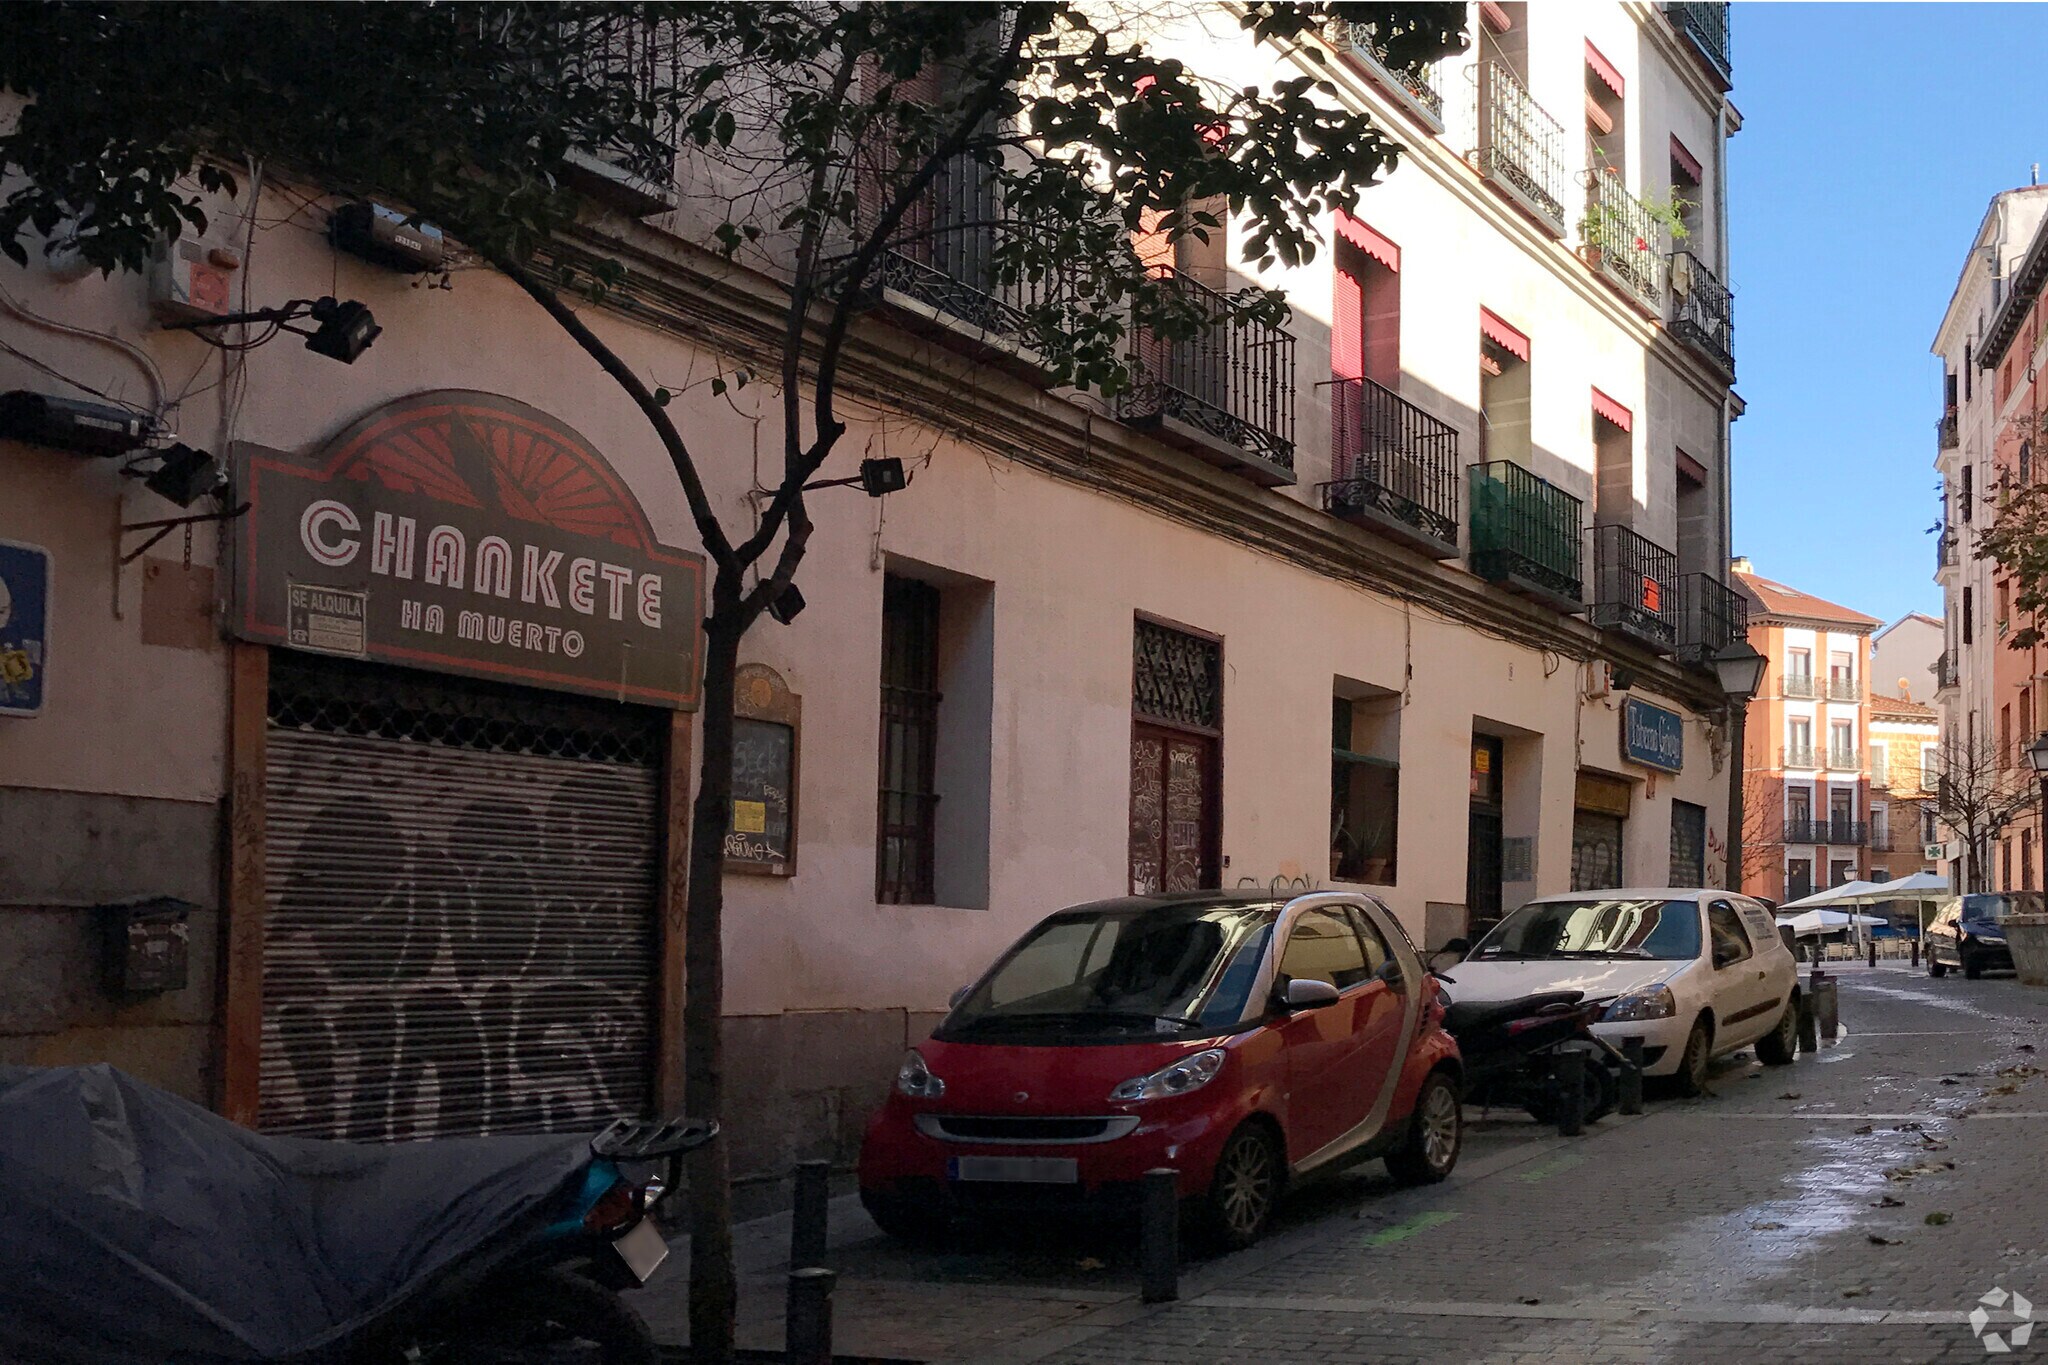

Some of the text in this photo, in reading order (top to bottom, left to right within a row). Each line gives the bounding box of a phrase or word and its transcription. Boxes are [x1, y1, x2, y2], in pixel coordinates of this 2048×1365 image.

[300, 499, 662, 629] CHANKETE
[292, 589, 362, 617] SE ALQUILA
[401, 599, 585, 658] HA MUERTO
